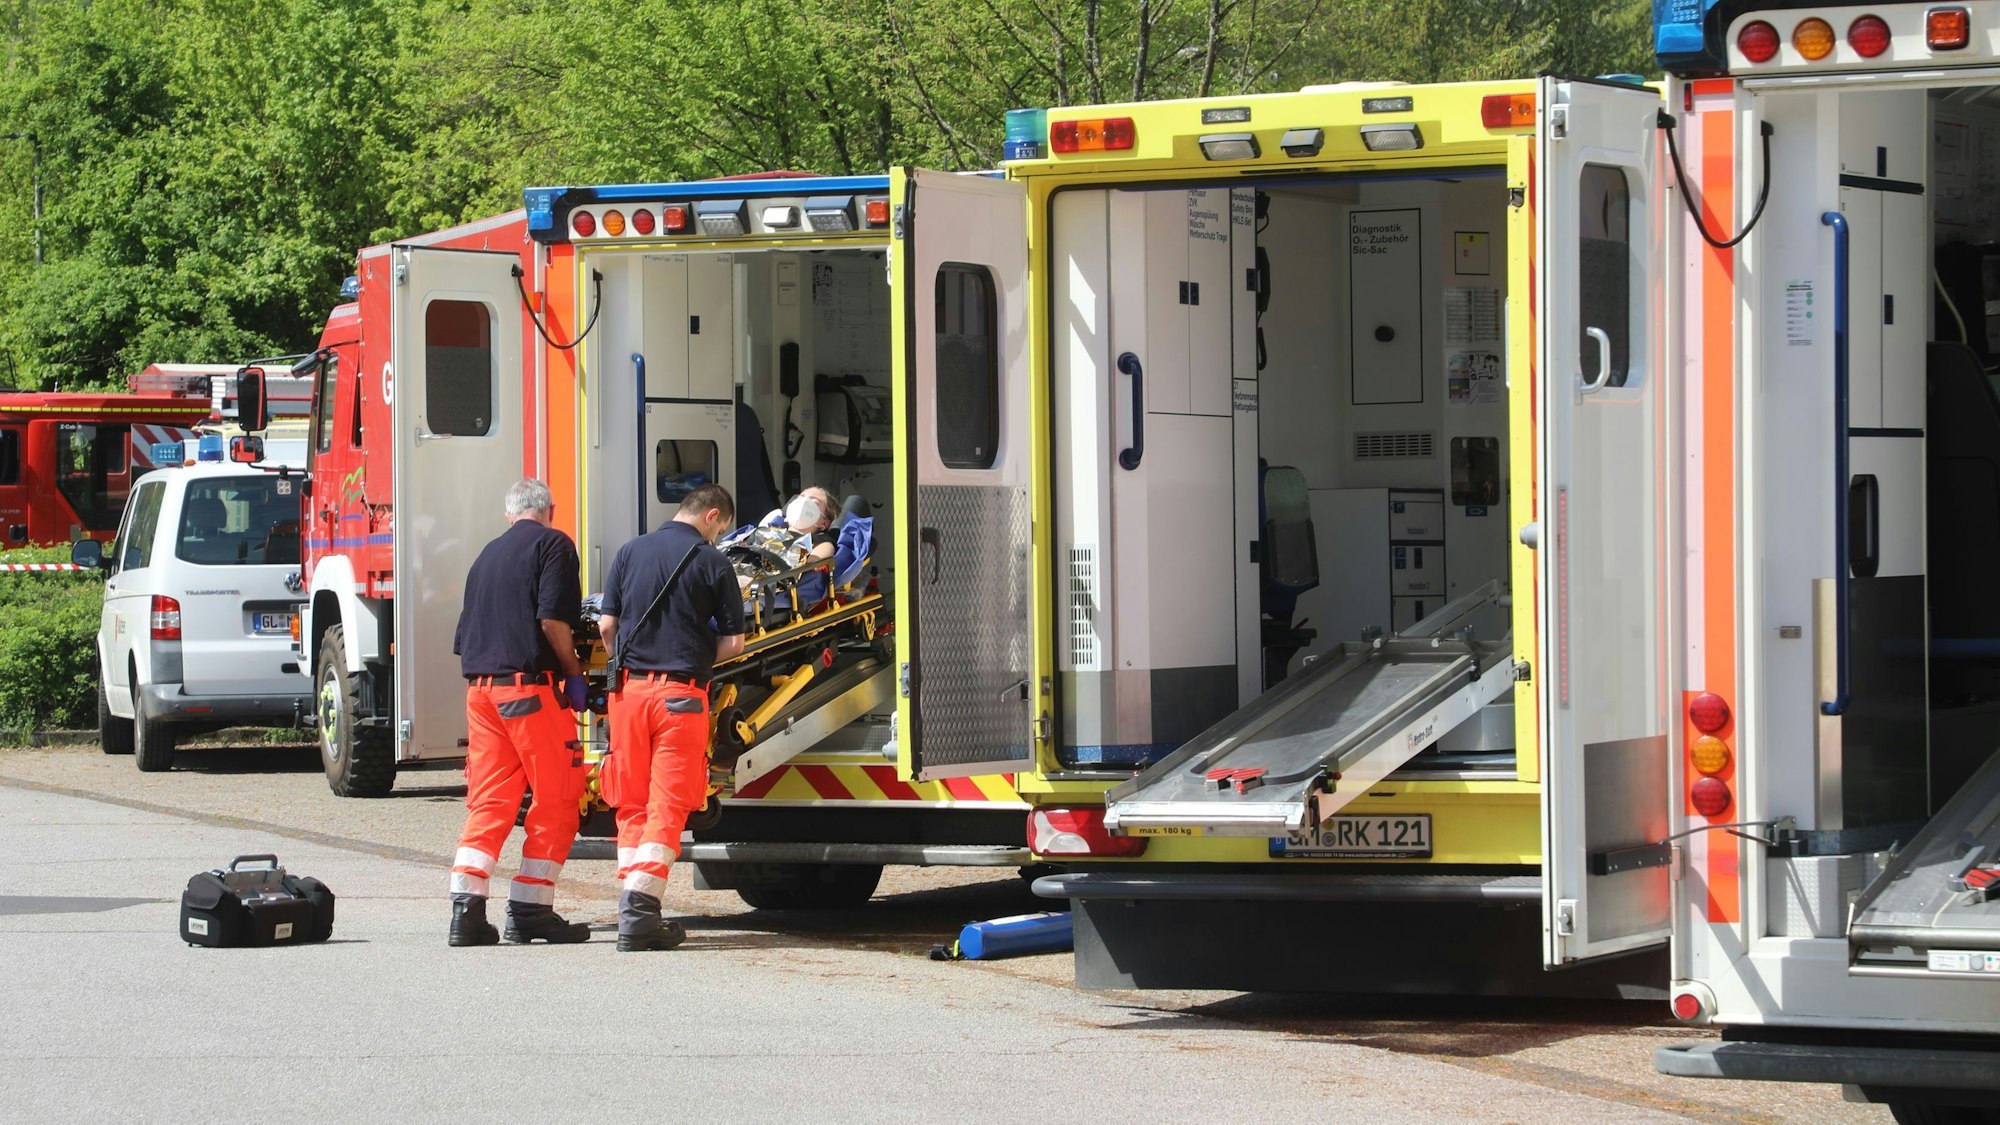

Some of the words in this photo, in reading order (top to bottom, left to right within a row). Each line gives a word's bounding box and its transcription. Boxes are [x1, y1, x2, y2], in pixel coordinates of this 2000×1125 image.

[1352, 224, 1402, 235] Diagnostik
[1352, 245, 1388, 254] Sic-Sac
[262, 615, 278, 629] GL
[1180, 826, 1192, 836] kg
[1338, 820, 1371, 847] RK
[1377, 820, 1426, 847] 121
